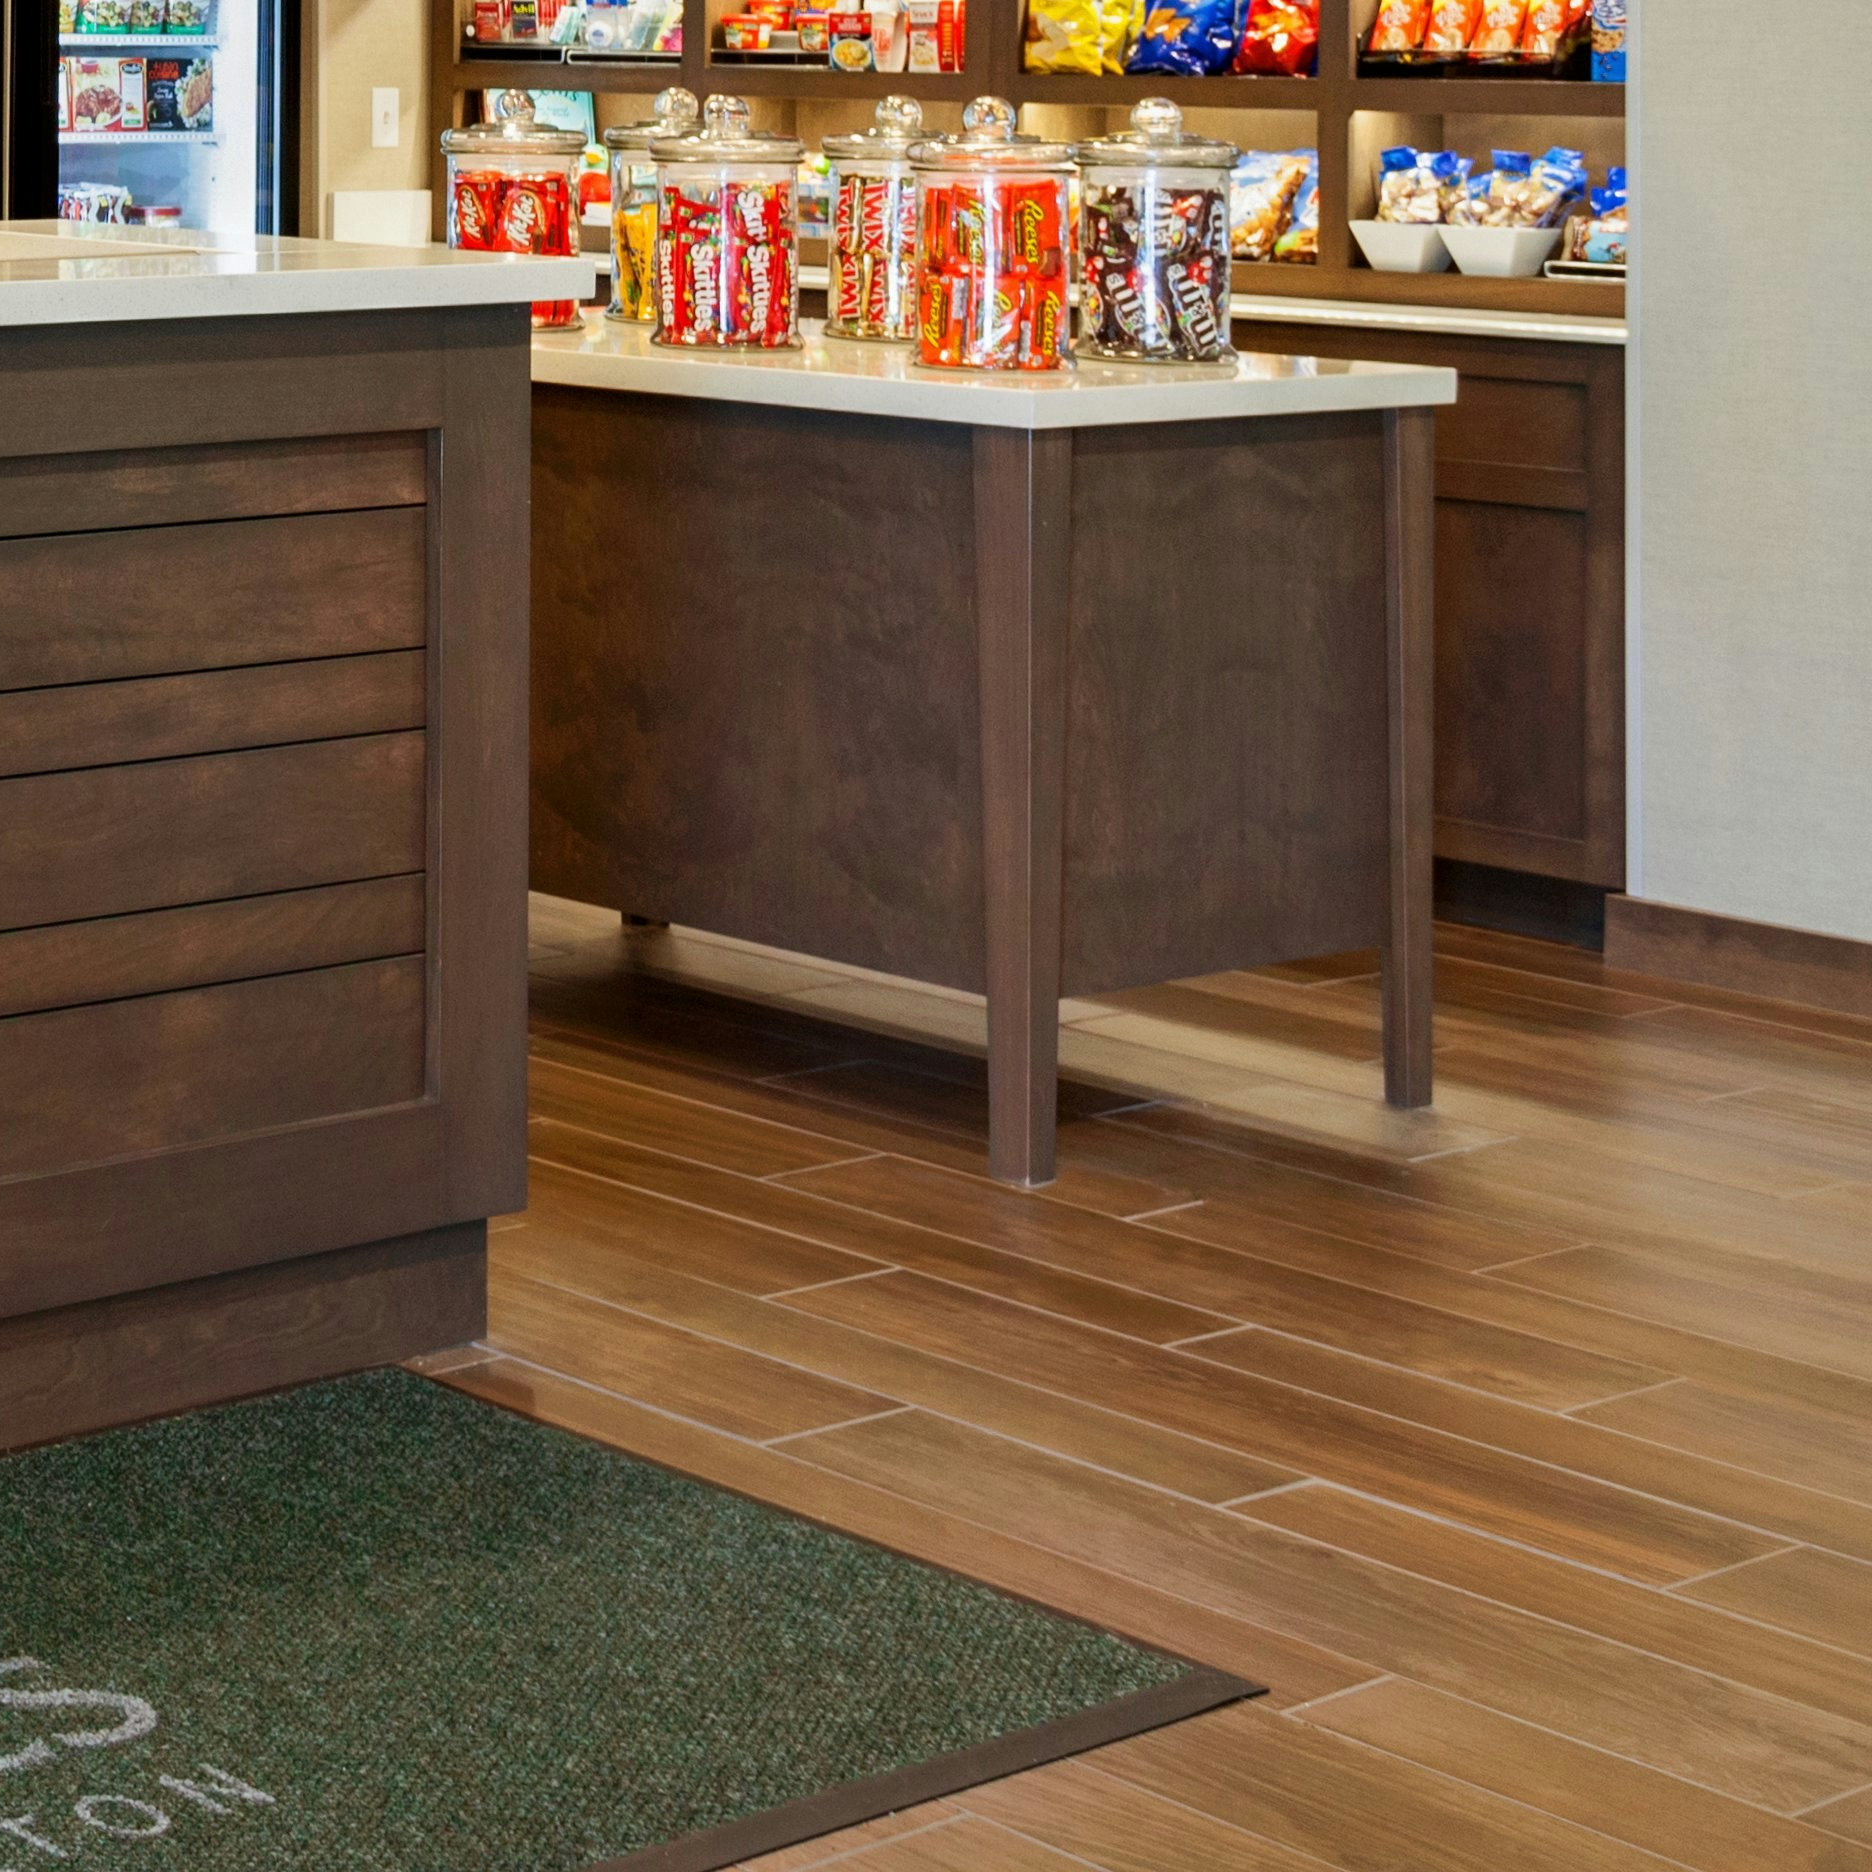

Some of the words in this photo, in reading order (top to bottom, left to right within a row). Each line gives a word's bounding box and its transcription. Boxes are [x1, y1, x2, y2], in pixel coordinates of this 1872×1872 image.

[737, 191, 767, 241] Skitt
[691, 244, 717, 331] Skittles
[747, 245, 770, 333] Skittles
